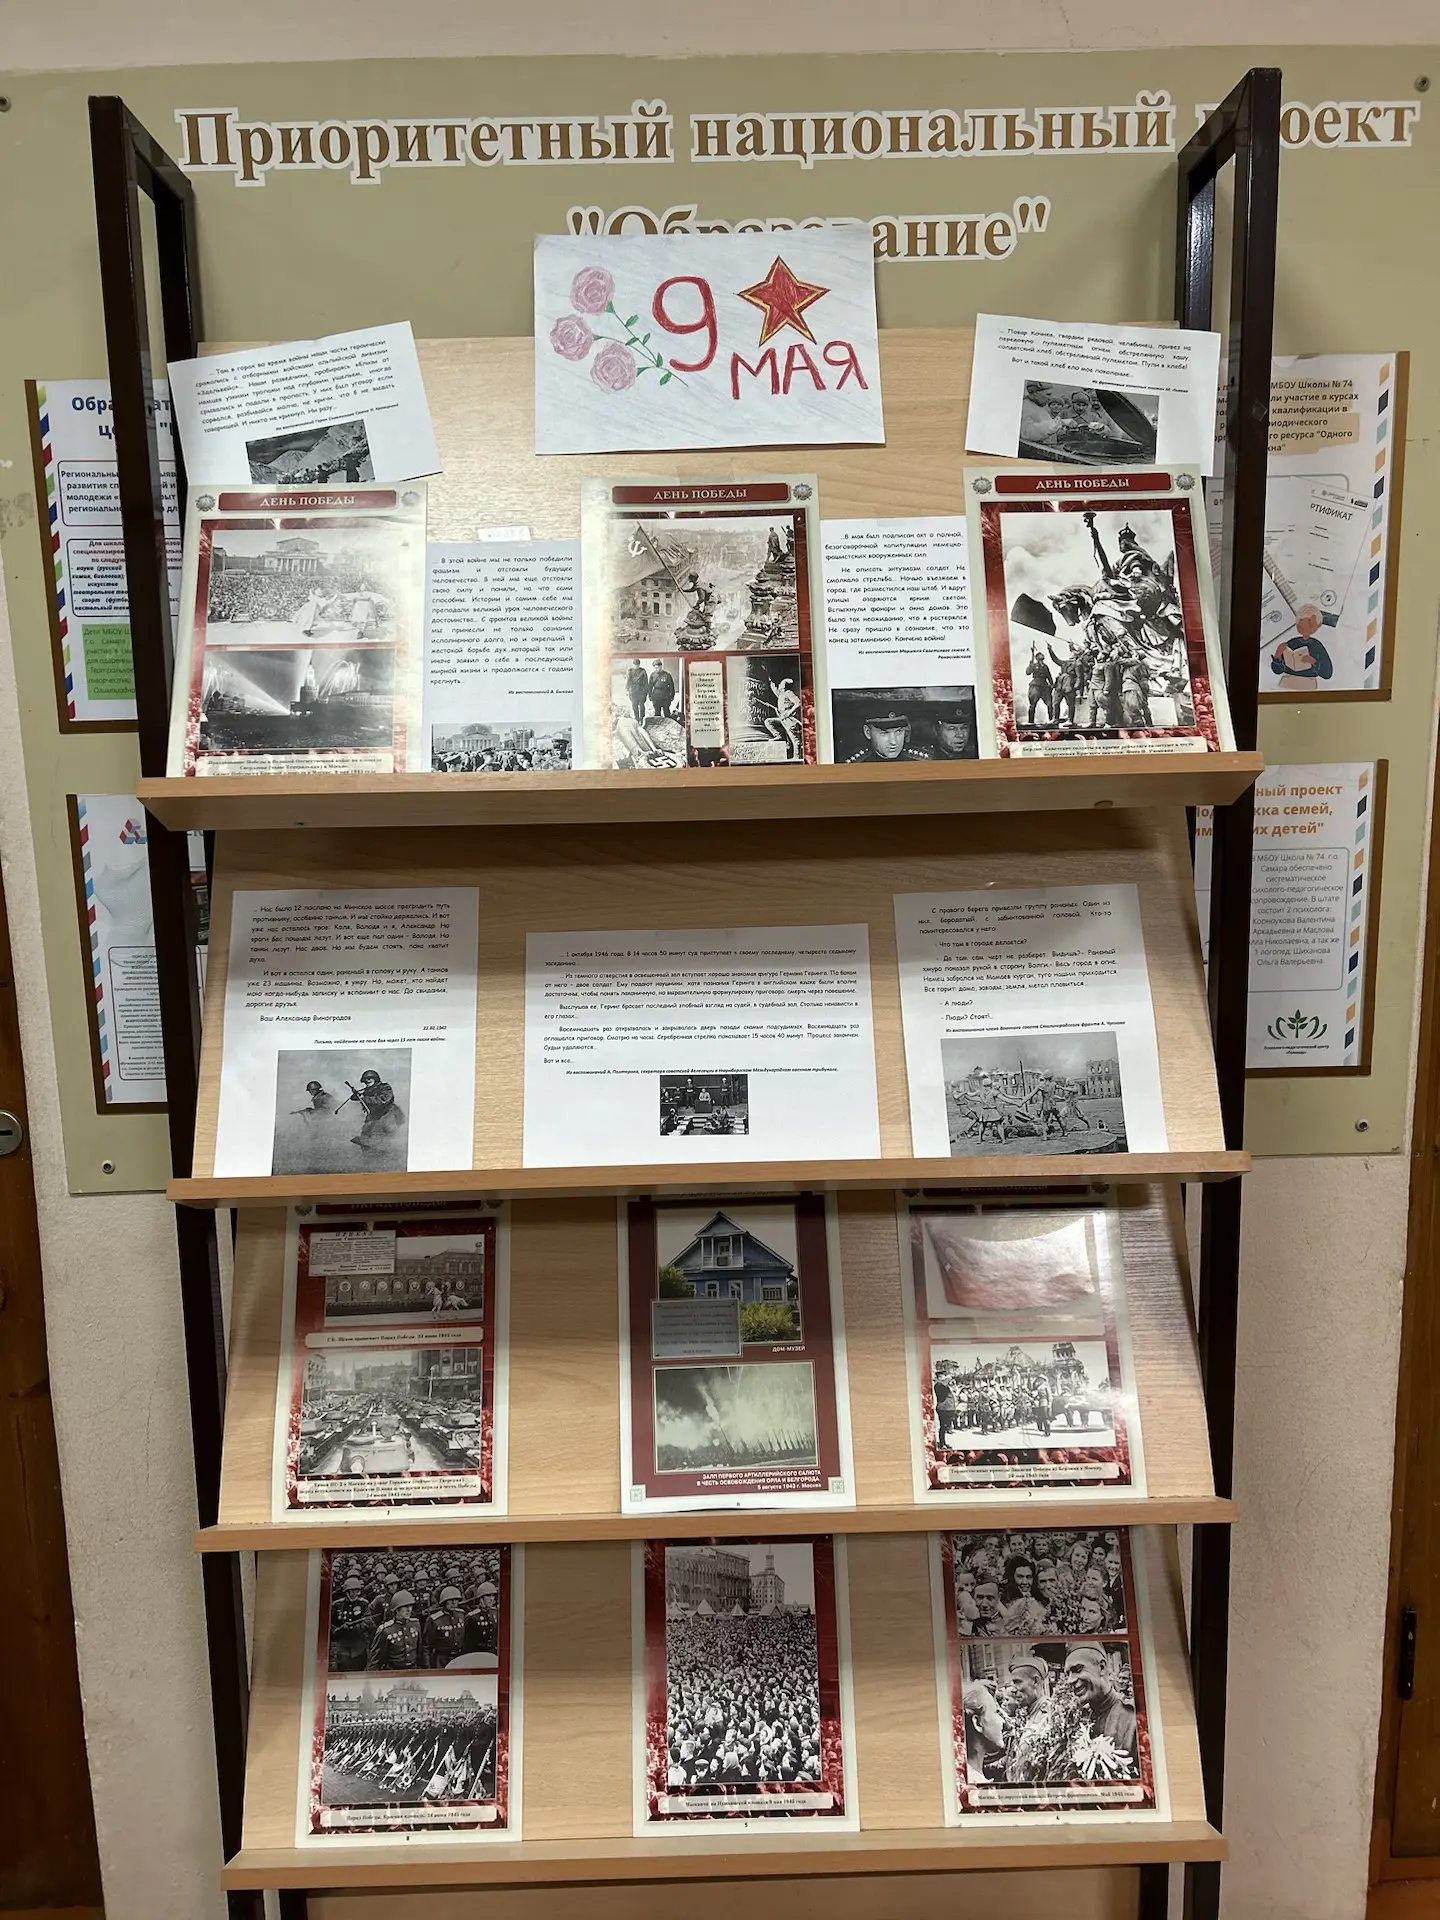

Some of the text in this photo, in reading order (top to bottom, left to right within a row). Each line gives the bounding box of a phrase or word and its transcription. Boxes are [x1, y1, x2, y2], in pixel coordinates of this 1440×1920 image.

[180, 105, 670, 181] Приоритетный
[694, 96, 1172, 165] национальный
[652, 275, 718, 373] 9
[731, 340, 869, 401] МАЯ
[1271, 382, 1296, 390] МБОУ
[1298, 380, 1330, 389] Школы
[1342, 380, 1353, 388] 74
[1284, 395, 1320, 403] участие
[1329, 393, 1359, 402] курсах
[1272, 406, 1340, 415] квалификации
[1280, 432, 1314, 441] ресурса
[67, 483, 107, 491] развития
[1036, 478, 1129, 490] ДЕНЬ ПОБЕДЫ
[653, 489, 747, 500] ДЕНЬ ПОБЕДЫ
[260, 495, 354, 508] ДЕНЬ ПОБЕДЫ
[1290, 786, 1343, 798] проект
[1283, 802, 1333, 816] семей,
[1271, 821, 1324, 837] детей"
[313, 1014, 351, 1022] Виноградов
